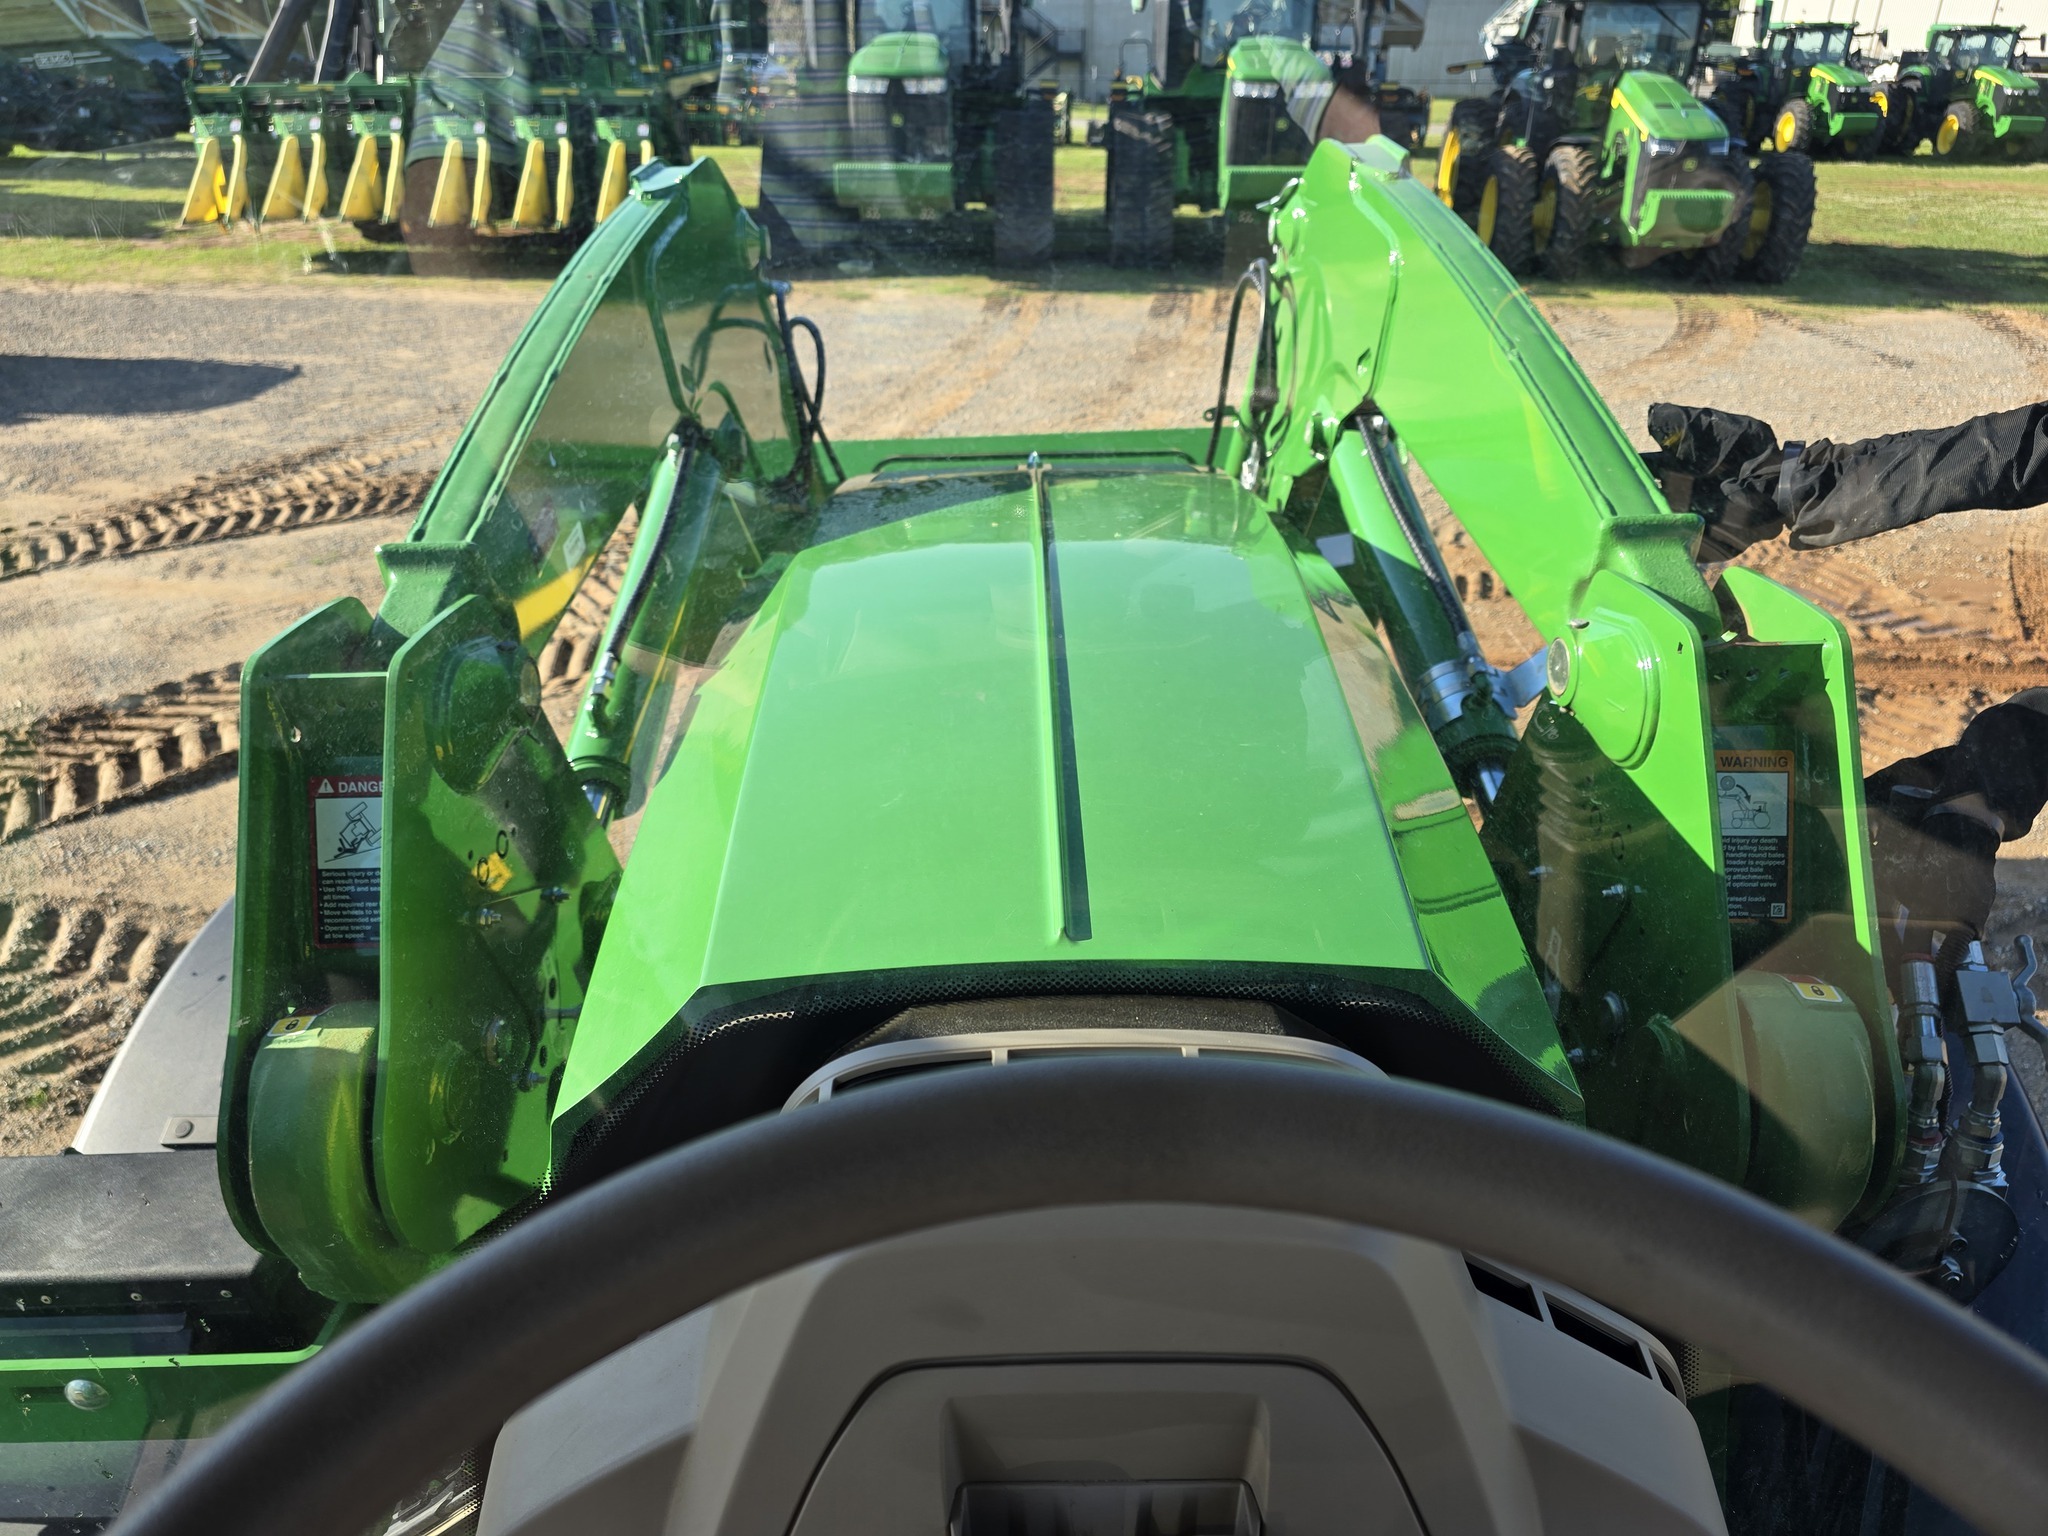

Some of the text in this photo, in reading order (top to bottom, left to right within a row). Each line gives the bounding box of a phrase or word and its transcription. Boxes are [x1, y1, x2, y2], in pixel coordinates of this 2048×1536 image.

[1720, 756, 1789, 768] WARNING
[338, 781, 383, 793] DANGE
[1731, 837, 1749, 846] injury
